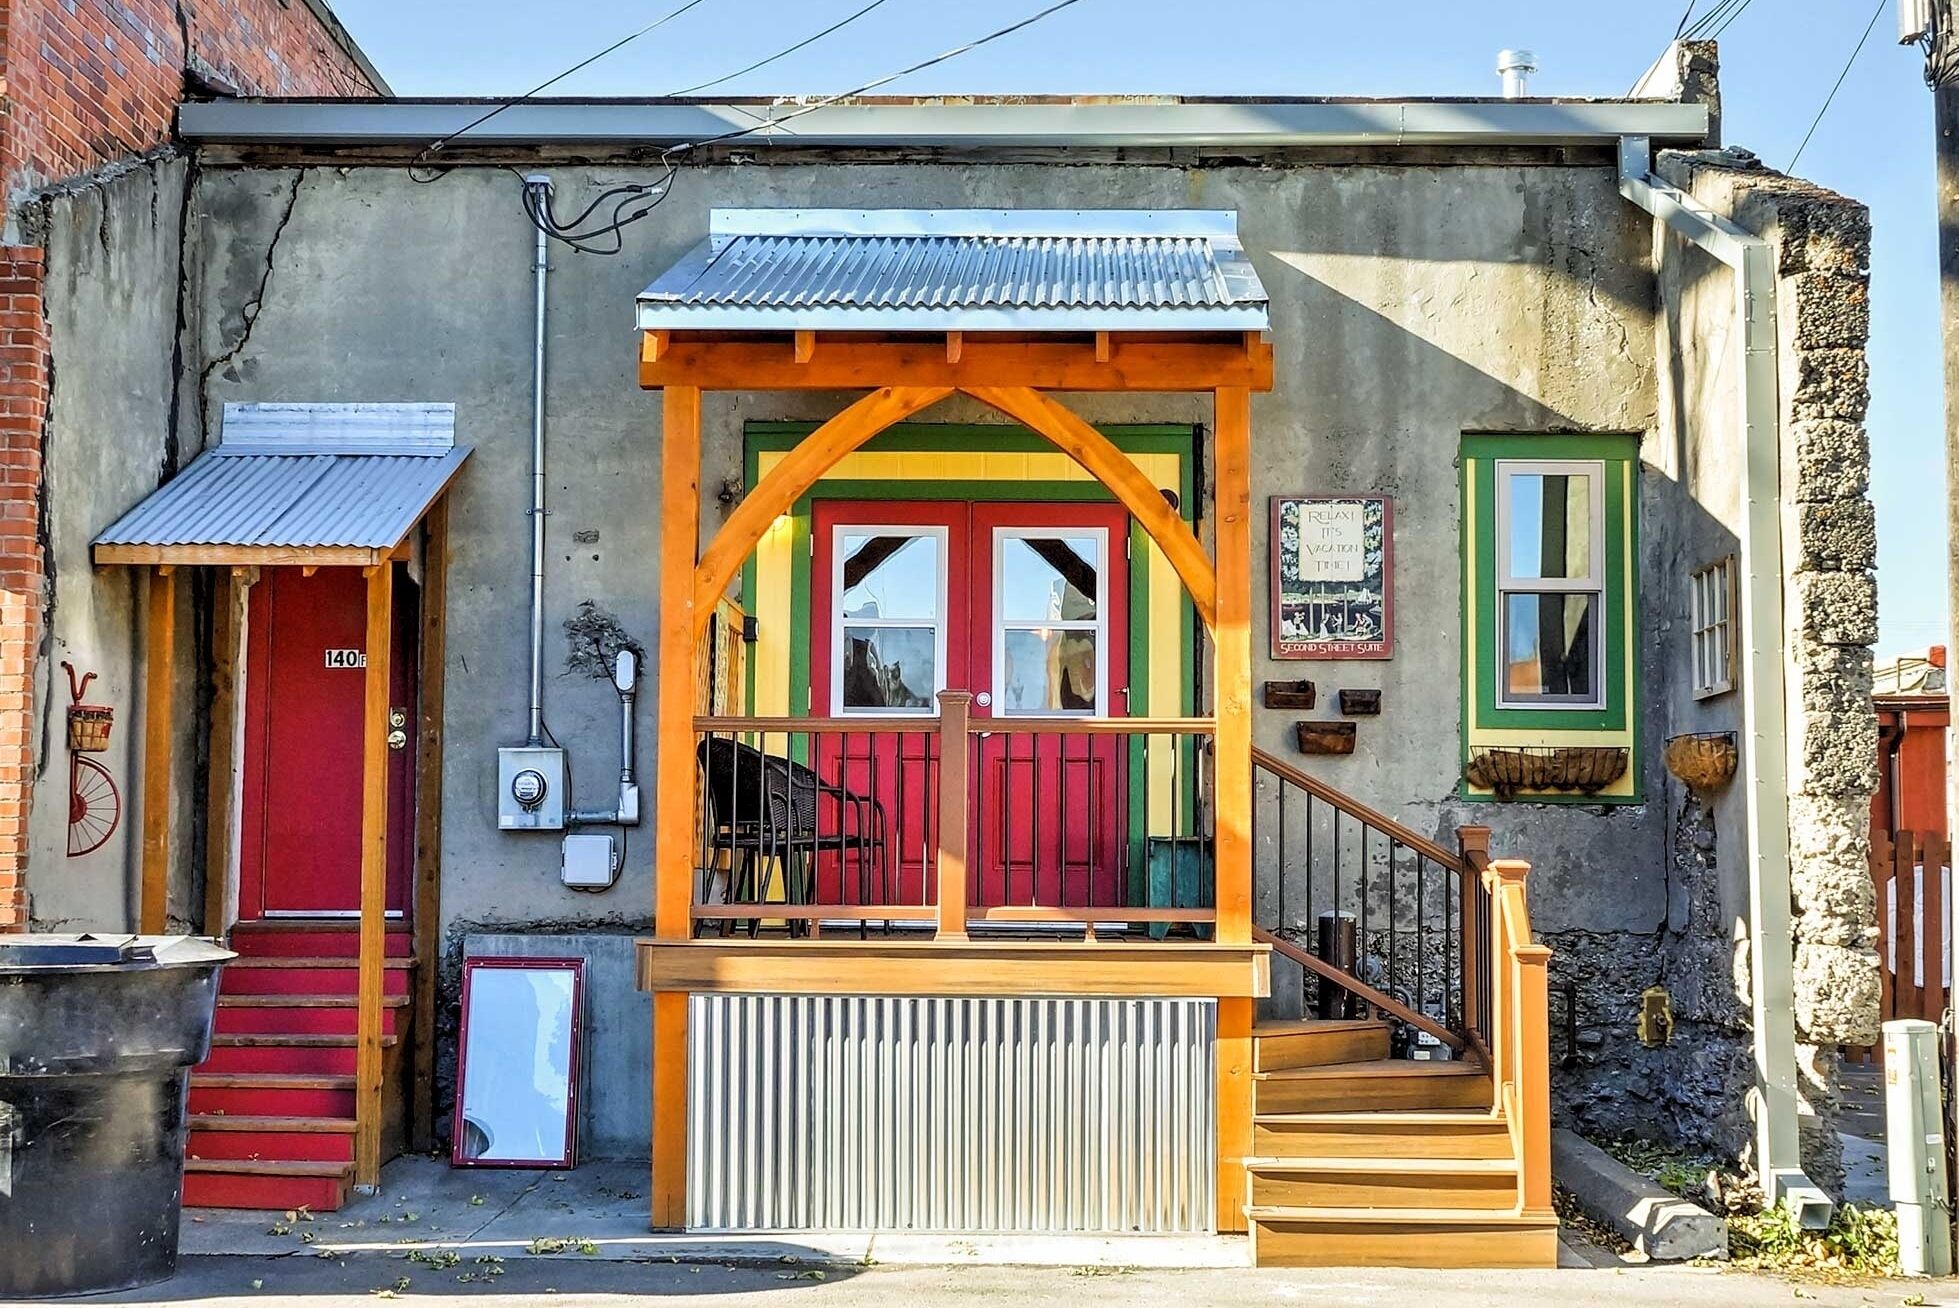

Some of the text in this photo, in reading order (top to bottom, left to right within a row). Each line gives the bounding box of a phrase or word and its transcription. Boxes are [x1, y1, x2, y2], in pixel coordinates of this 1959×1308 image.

[1320, 527, 1342, 539] IT'S
[1306, 544, 1358, 556] VACATION
[1280, 643, 1384, 654] SECOND STREET SUITE
[327, 651, 357, 666] 140
